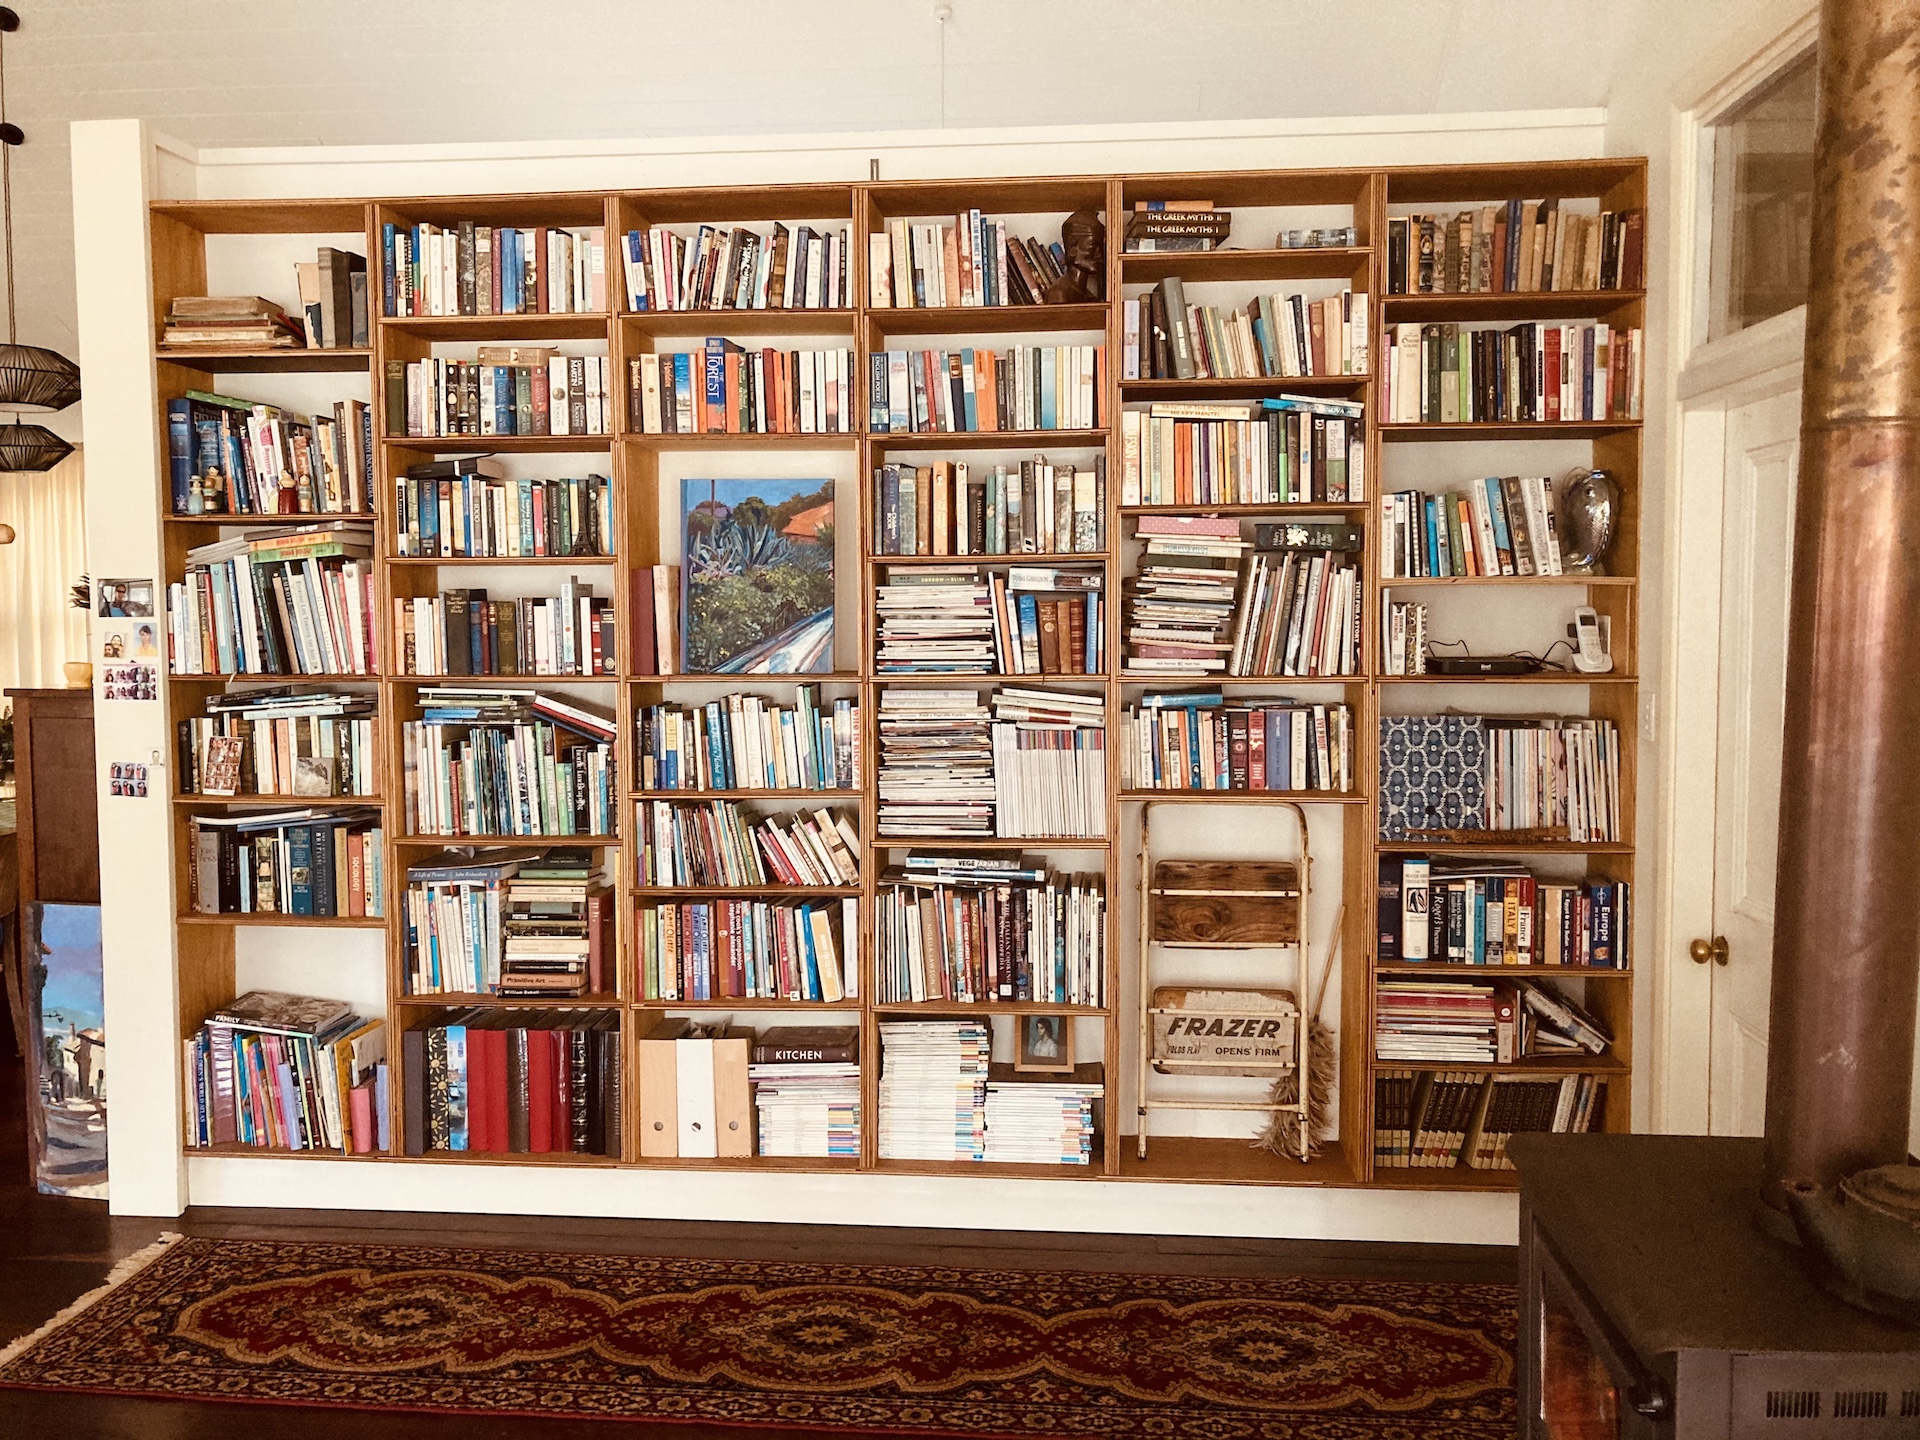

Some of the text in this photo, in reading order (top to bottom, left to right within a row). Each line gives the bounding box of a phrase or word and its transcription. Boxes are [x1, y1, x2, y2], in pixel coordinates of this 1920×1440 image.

[1175, 321, 1187, 359] DAVID MALOUF
[708, 356, 723, 398] FOREST
[364, 417, 372, 452] GEOGRAPHY
[1125, 420, 1138, 458] WOLFSKIN
[1329, 430, 1337, 457] Bryson
[1494, 492, 1504, 523] FORTUNE
[283, 577, 292, 604] EUROPE
[296, 581, 306, 603] EVERYDAY
[303, 616, 311, 638] THROUGH
[748, 729, 756, 752] Natural
[854, 734, 860, 742] IS
[576, 750, 584, 768] home
[352, 856, 360, 892] SOCIOLOGY
[1433, 896, 1444, 924] Roget's
[1507, 902, 1516, 929] ITALY
[1599, 907, 1610, 941] Europe
[1491, 909, 1500, 940] Europe
[1519, 912, 1530, 942] France
[216, 1014, 240, 1024] FAMILY
[1168, 1018, 1280, 1038] FRAZER
[775, 1051, 822, 1060] KITCHEN
[1167, 1046, 1186, 1054] FOLDS
